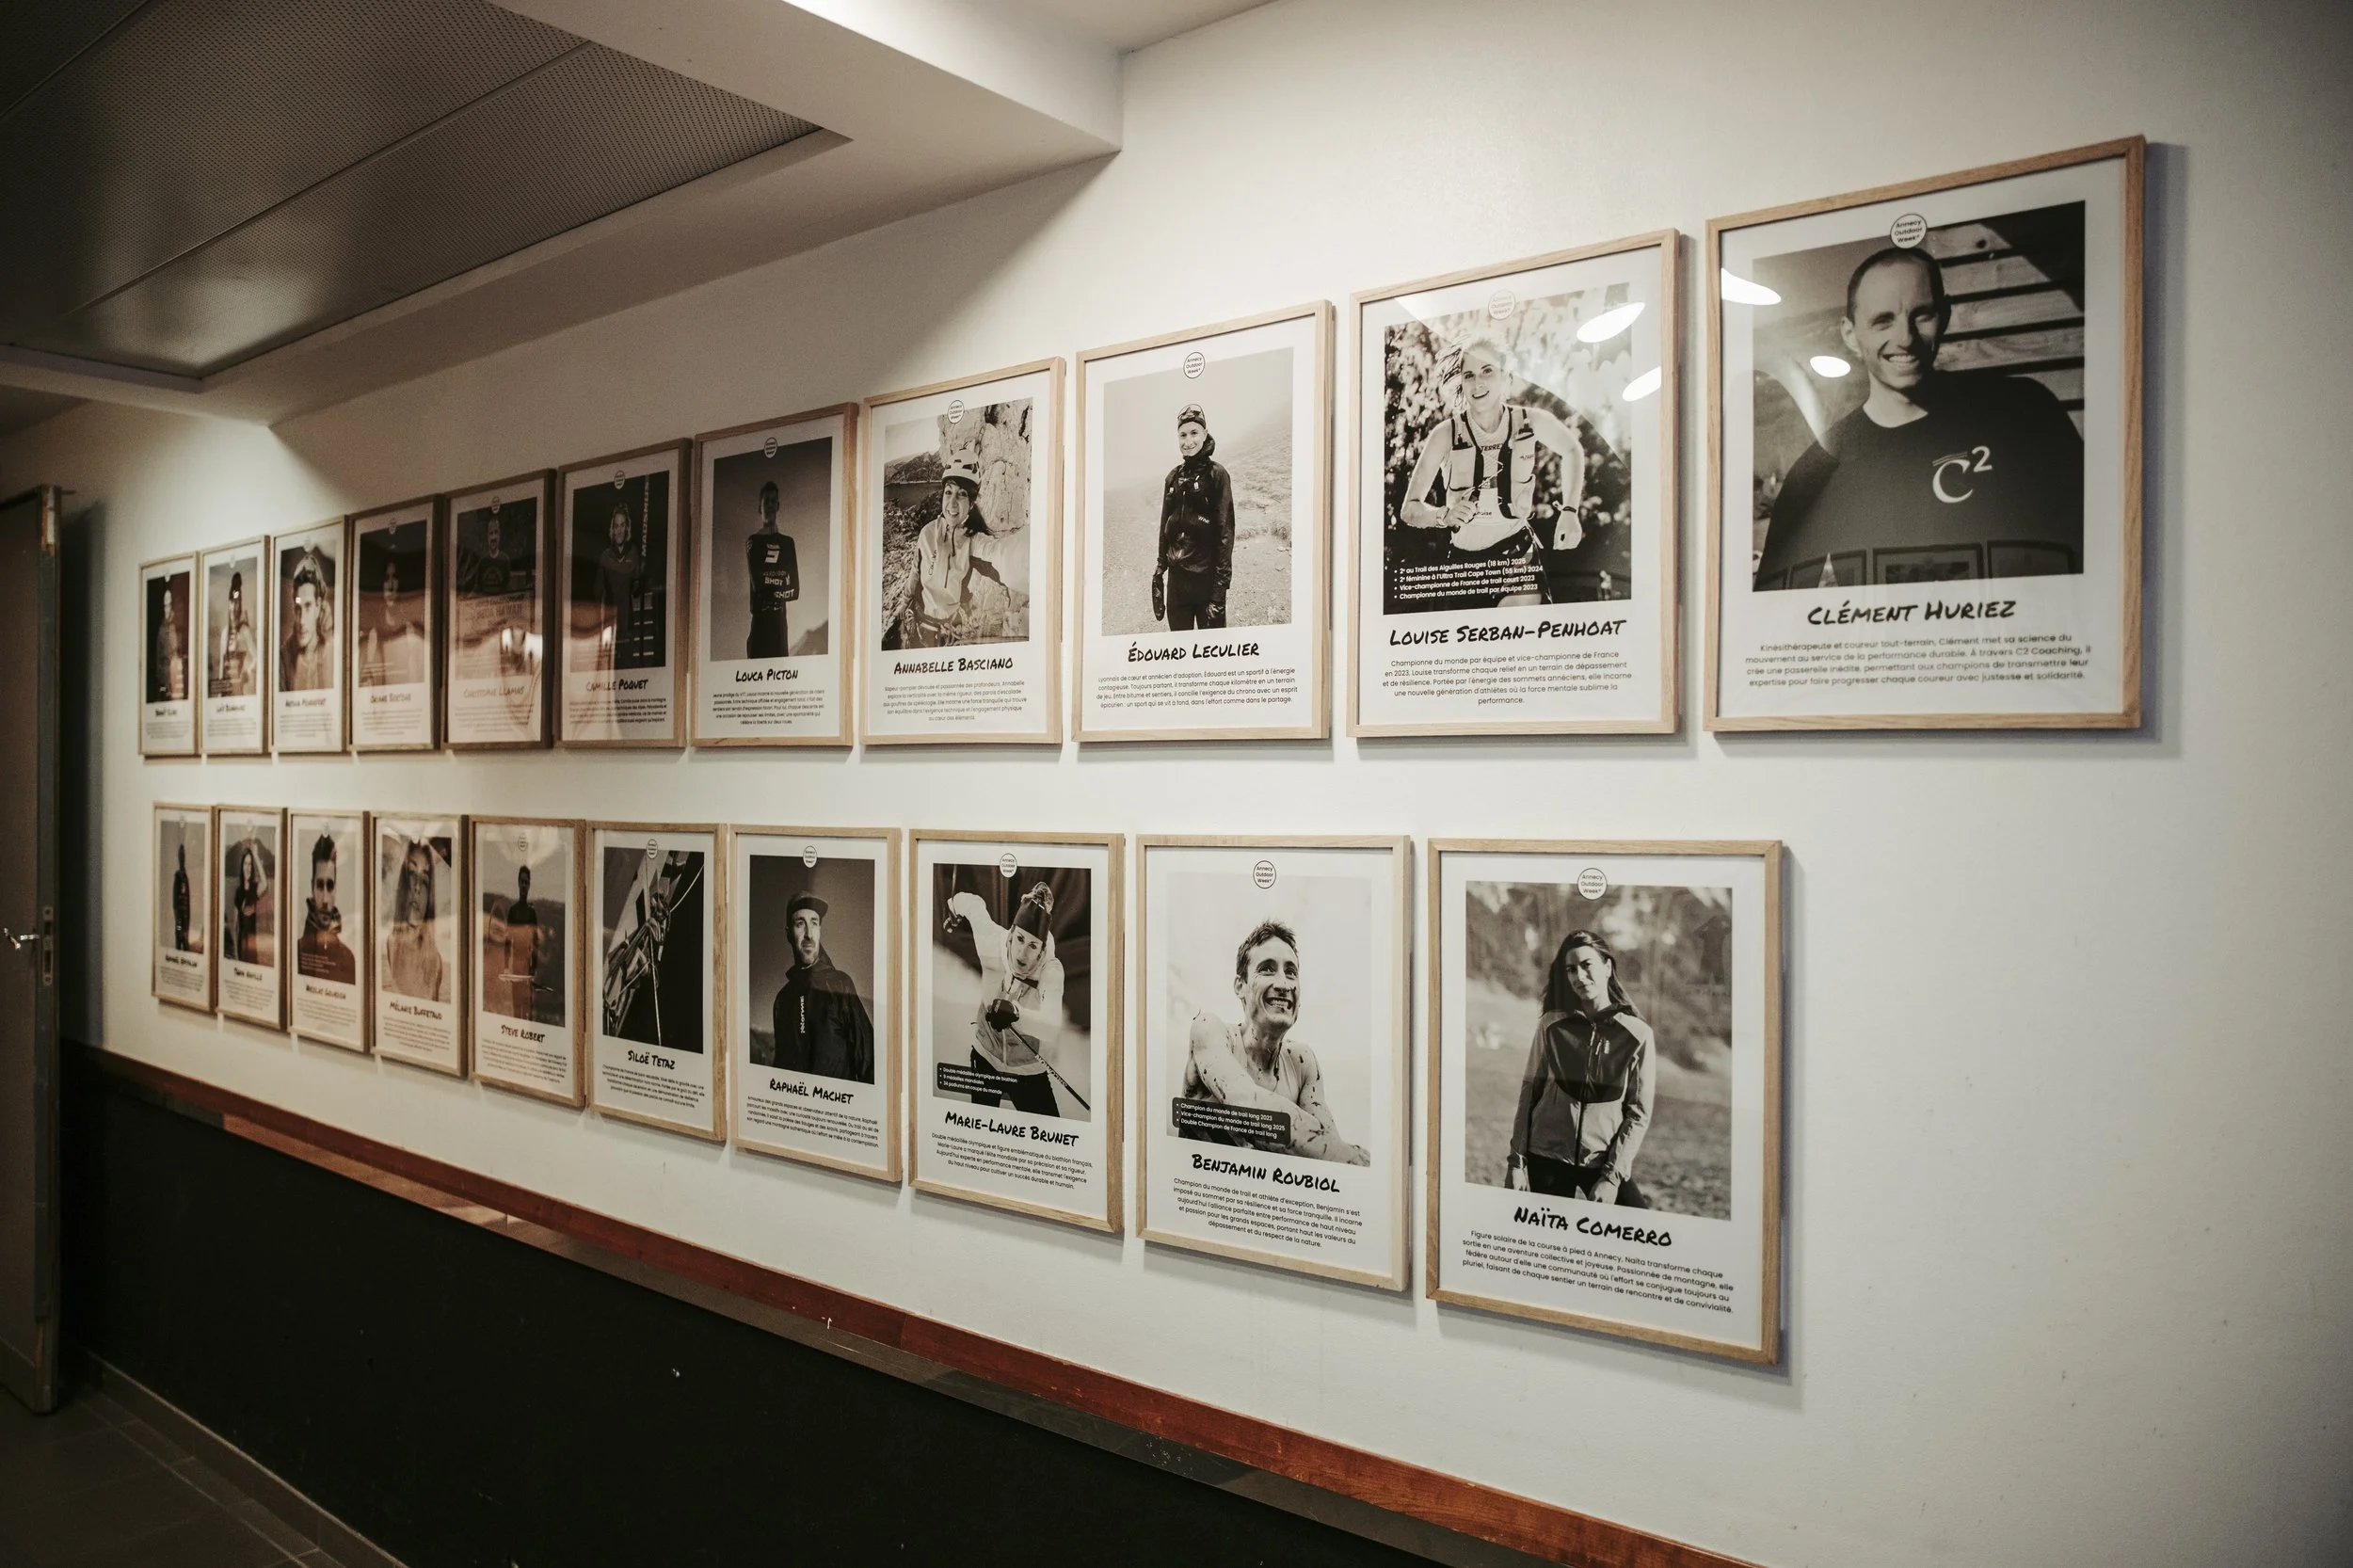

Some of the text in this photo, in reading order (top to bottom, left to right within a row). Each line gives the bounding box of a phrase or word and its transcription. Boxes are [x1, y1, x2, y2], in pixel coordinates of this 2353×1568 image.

[1895, 228, 1922, 236] Outdoor
[1896, 219, 1922, 229] Annecy
[764, 577, 784, 586] SHOT
[1399, 581, 1450, 591] Vice-championne
[1450, 579, 1459, 587] de
[1459, 578, 1481, 586] France
[1489, 575, 1502, 584] trail
[1502, 574, 1520, 583] court
[1519, 572, 1535, 582] 2023
[1399, 590, 1436, 600] Championne
[1436, 588, 1445, 597] du
[1445, 586, 1466, 596] monde
[1476, 584, 1488, 594] trail
[1488, 586, 1500, 595] par
[1499, 584, 1522, 594] équipe
[1522, 582, 1538, 590] 2023
[1807, 600, 2016, 625] CLÉMENT HURIEZ
[1389, 619, 1626, 646] LOUISE SERBAN-PENHOAT
[1128, 641, 1260, 663] ÉDOUARD LECULIER
[1390, 650, 1619, 668] Championne du monde par équipe et vice-championne de France
[735, 668, 799, 682] LOUCA PICTON
[893, 657, 1014, 675] ANNABELLE BASCIANO
[1411, 666, 1433, 676] Louise
[1433, 665, 1470, 675] transforme
[1471, 664, 1497, 675] chaque
[1498, 664, 1516, 673] relief
[1538, 662, 1562, 671] terrain
[1563, 662, 1574, 670] de
[1575, 660, 1626, 672] dépassement
[618, 679, 648, 691] POQUET
[501, 1024, 546, 1044] STEVE ROBERT
[628, 1050, 676, 1070] SILOË TETAZ
[770, 1078, 855, 1104] RAPHAËL MACHET
[1180, 1101, 1206, 1112] Champion
[1206, 1104, 1212, 1112] du
[1212, 1107, 1230, 1115] monde
[1230, 1108, 1238, 1116] de
[1248, 1111, 1259, 1121] long
[1260, 1112, 1273, 1121] 2023
[1180, 1109, 1285, 1131] Vice-champion du monde de trail long 2025
[945, 1111, 1080, 1147] MARIE-LAURE BRUNET
[1180, 1116, 1277, 1140] Double Champion de France de trail long
[1192, 1154, 1341, 1193] BENJAMIN ROUBIOL
[1173, 1176, 1202, 1190] Champion
[1202, 1181, 1210, 1191] du
[1210, 1184, 1230, 1193] monde
[1231, 1186, 1239, 1195] de
[1240, 1188, 1251, 1197] trail
[1257, 1192, 1279, 1202] athlète
[1316, 1201, 1345, 1214] Benjamin
[1345, 1207, 1360, 1217] s'est
[1176, 1195, 1355, 1235] aujourd'hui l'alliance parfaite entre performance de haut niveau
[1513, 1206, 1673, 1247] NAÏTA COMERRO
[1462, 1238, 1481, 1248] sortie
[1481, 1241, 1491, 1250] en
[1492, 1243, 1506, 1253] une
[1507, 1246, 1539, 1258] aventure
[1540, 1251, 1575, 1264] collective
[1576, 1256, 1583, 1266] et
[1616, 1262, 1660, 1279] Passionnée
[1661, 1270, 1672, 1281] de
[1719, 1281, 1734, 1291] elle
[1470, 1228, 1492, 1241] Figure
[1493, 1234, 1516, 1245] solaire
[1517, 1236, 1527, 1247] de
[1528, 1238, 1535, 1248] la
[1536, 1241, 1561, 1253] course
[1561, 1243, 1568, 1254] à
[1569, 1245, 1585, 1256] pied
[1586, 1248, 1593, 1257] à
[1625, 1254, 1645, 1267] Naïta
[1646, 1258, 1690, 1273] transforme
[1691, 1266, 1723, 1280] chaque
